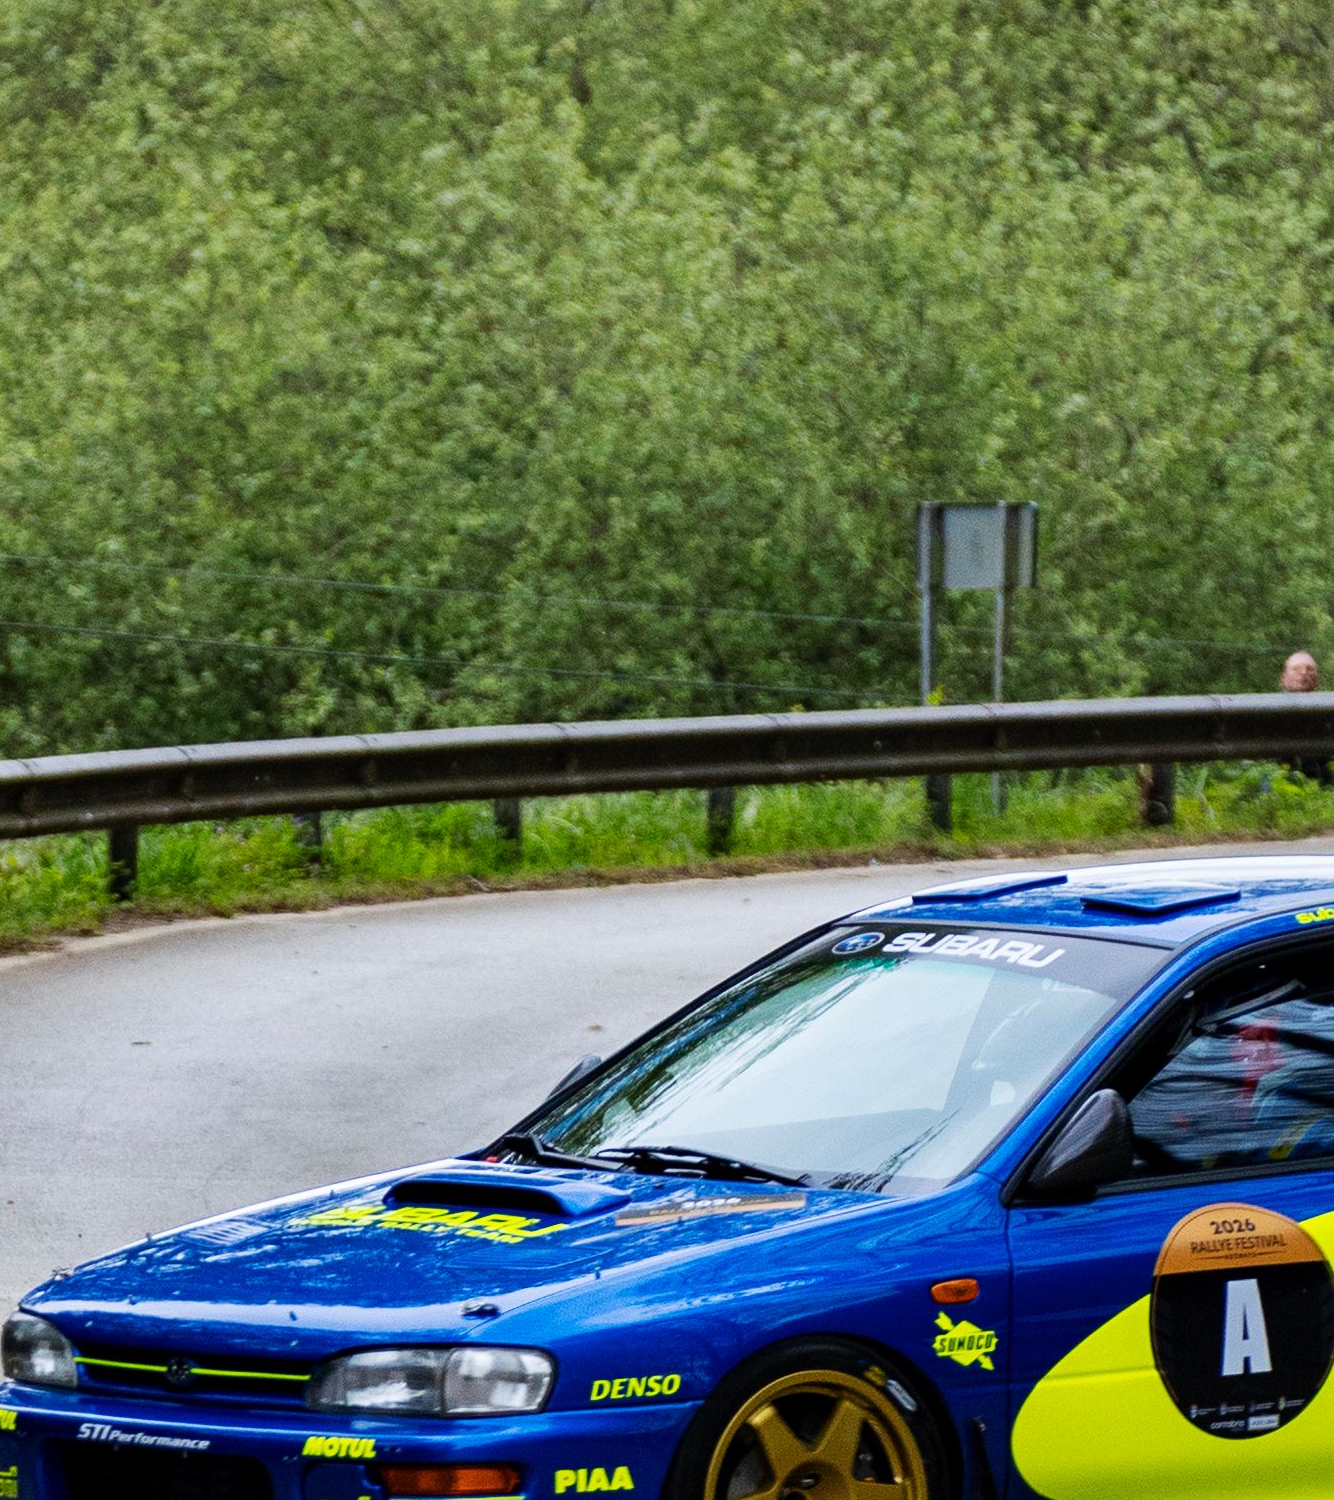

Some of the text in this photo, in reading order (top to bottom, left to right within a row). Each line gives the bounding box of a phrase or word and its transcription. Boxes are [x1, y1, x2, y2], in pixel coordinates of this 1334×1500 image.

[882, 932, 1066, 968] SUBARU
[1209, 1218, 1256, 1235] 2026
[1190, 1233, 1287, 1254] RALLYE FESTIVAL
[1221, 1278, 1273, 1376] A
[590, 1373, 682, 1401] DENSO
[77, 1422, 210, 1450] STI Performance
[301, 1435, 376, 1459] MOTUL
[554, 1465, 635, 1495] PIAA
